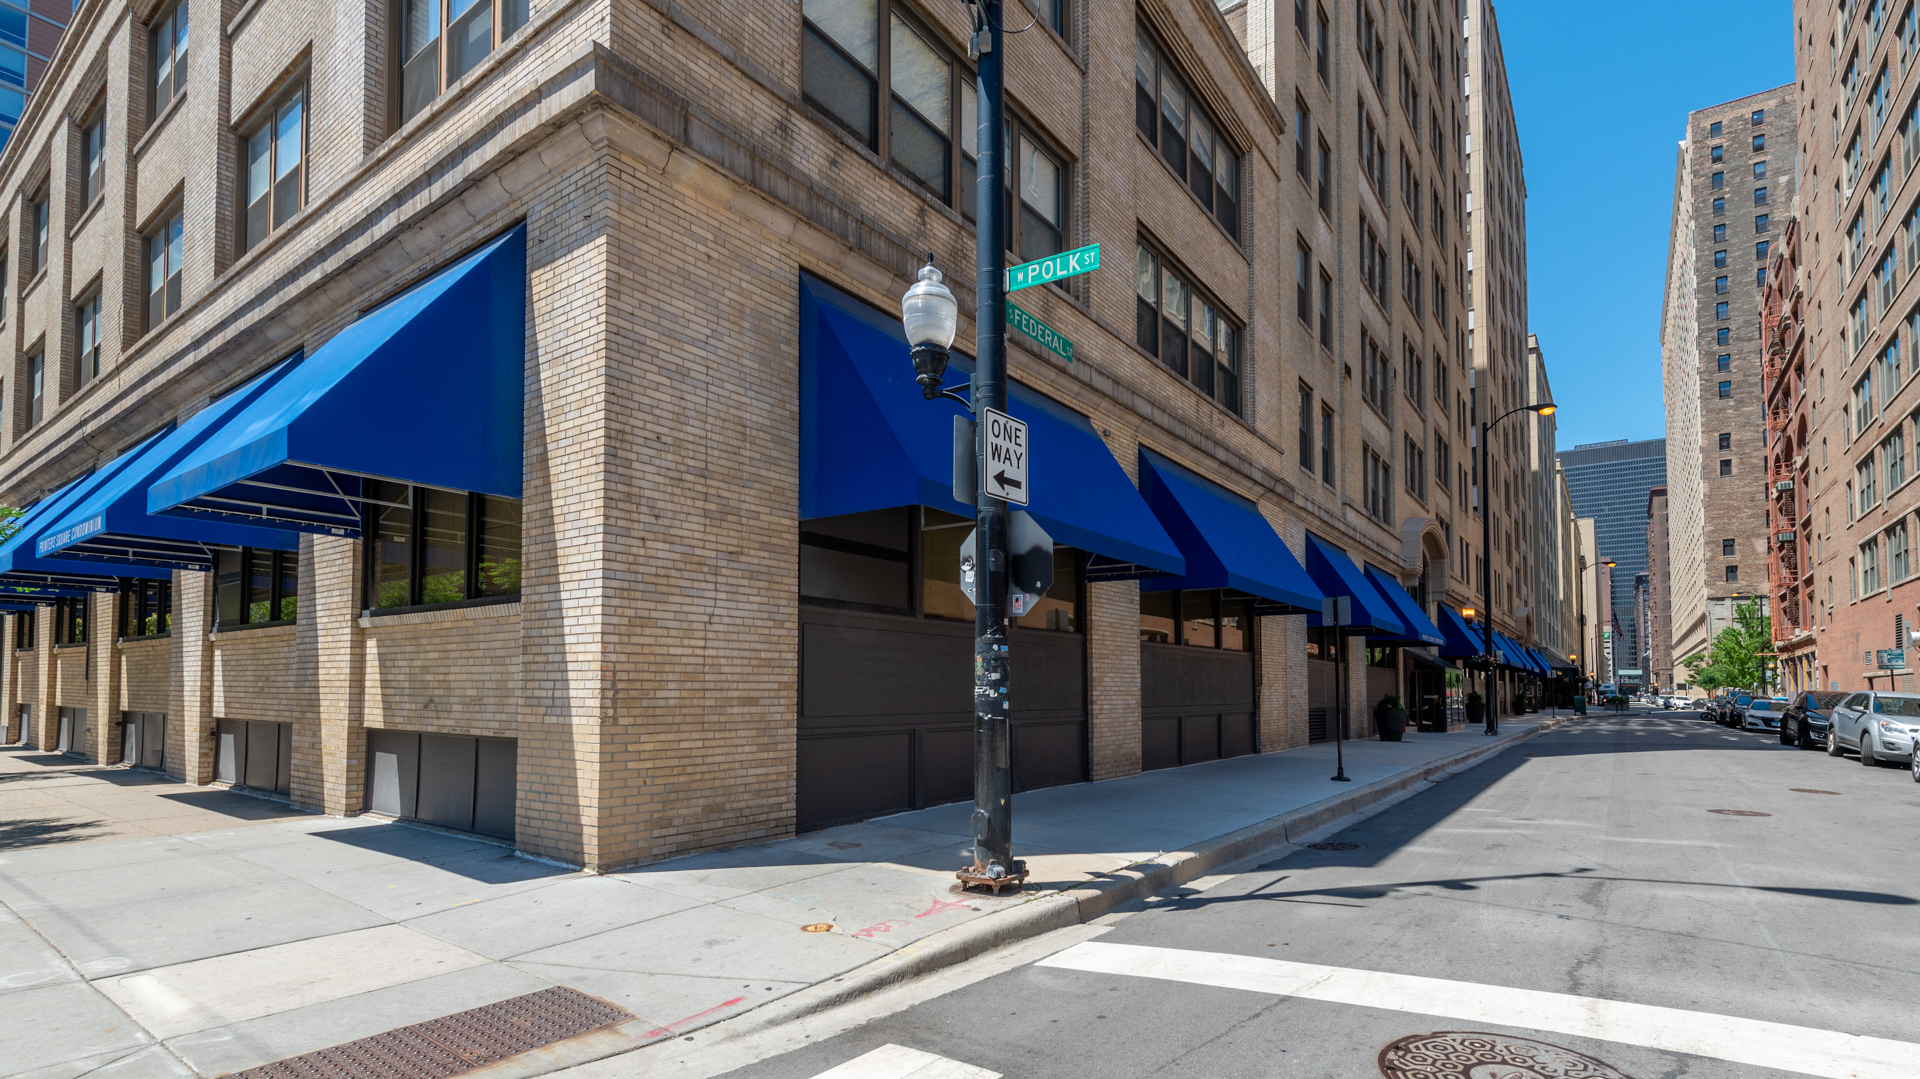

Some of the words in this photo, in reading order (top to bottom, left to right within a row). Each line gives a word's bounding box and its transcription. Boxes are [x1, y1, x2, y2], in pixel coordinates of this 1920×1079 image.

[1017, 272, 1024, 282] W
[1028, 252, 1081, 284] POLK
[1084, 251, 1096, 265] ST
[1009, 308, 1014, 319] S
[1014, 308, 1067, 357] FEDERAL
[1067, 346, 1073, 358] ST
[991, 419, 1022, 447] ONE
[990, 441, 1024, 470] WAY
[39, 535, 56, 553] PRINTERS
[56, 529, 71, 547] SQUARE
[71, 516, 101, 540] CONDOMINIUM
